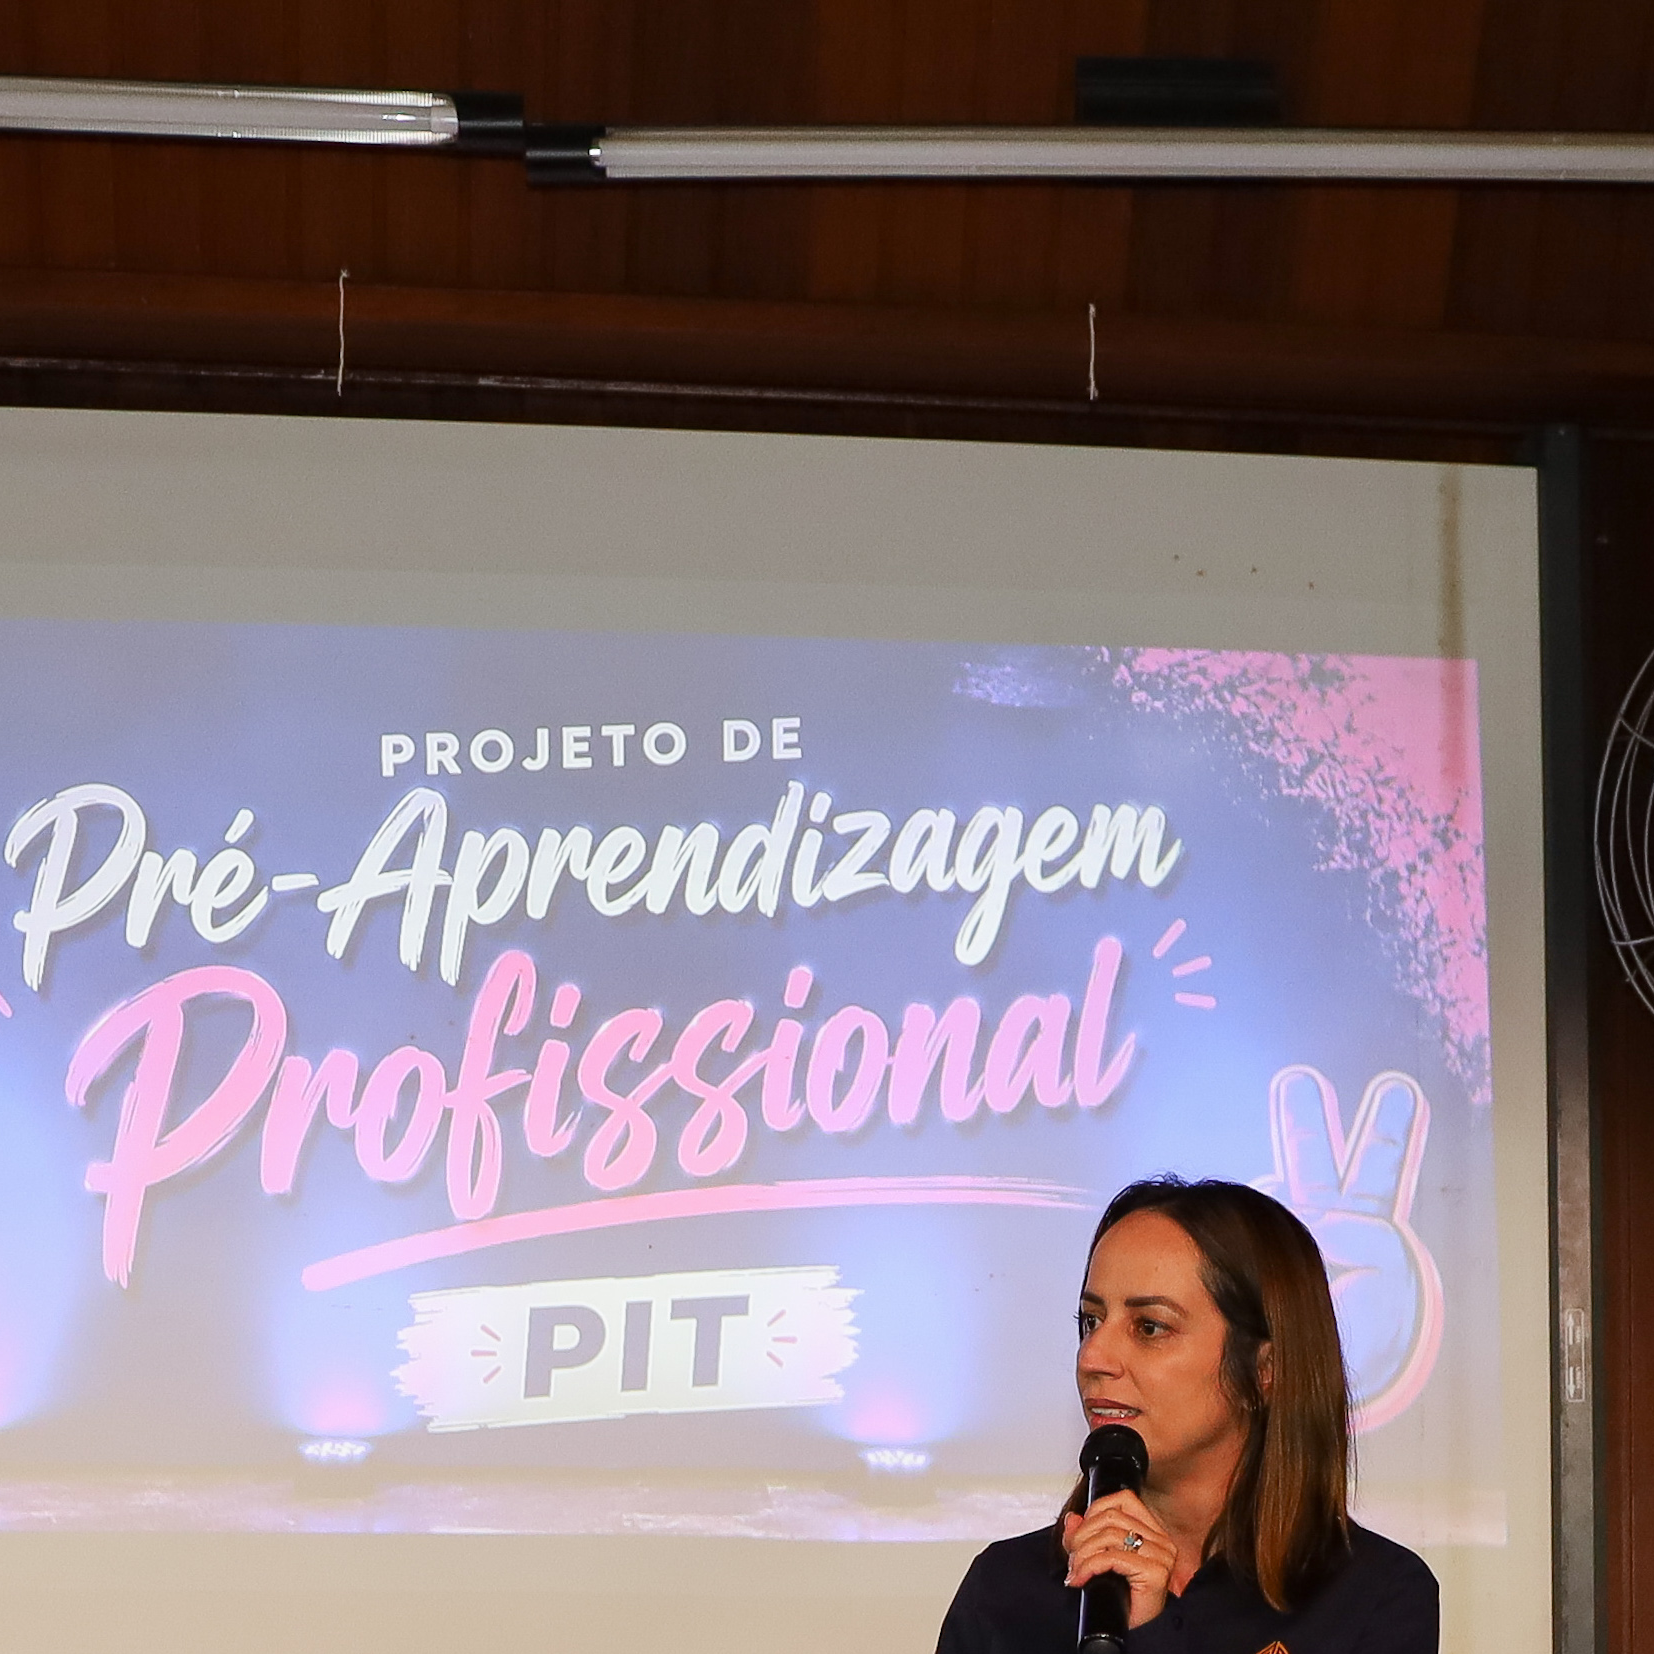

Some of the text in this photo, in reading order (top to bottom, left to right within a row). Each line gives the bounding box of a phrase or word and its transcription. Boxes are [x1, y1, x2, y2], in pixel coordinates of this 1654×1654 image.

[380, 716, 803, 777] PROJETO DE
[4, 779, 1183, 992] Pré-Aprendizagem
[65, 936, 1136, 1289] Profissional
[524, 1294, 750, 1399] PIT
